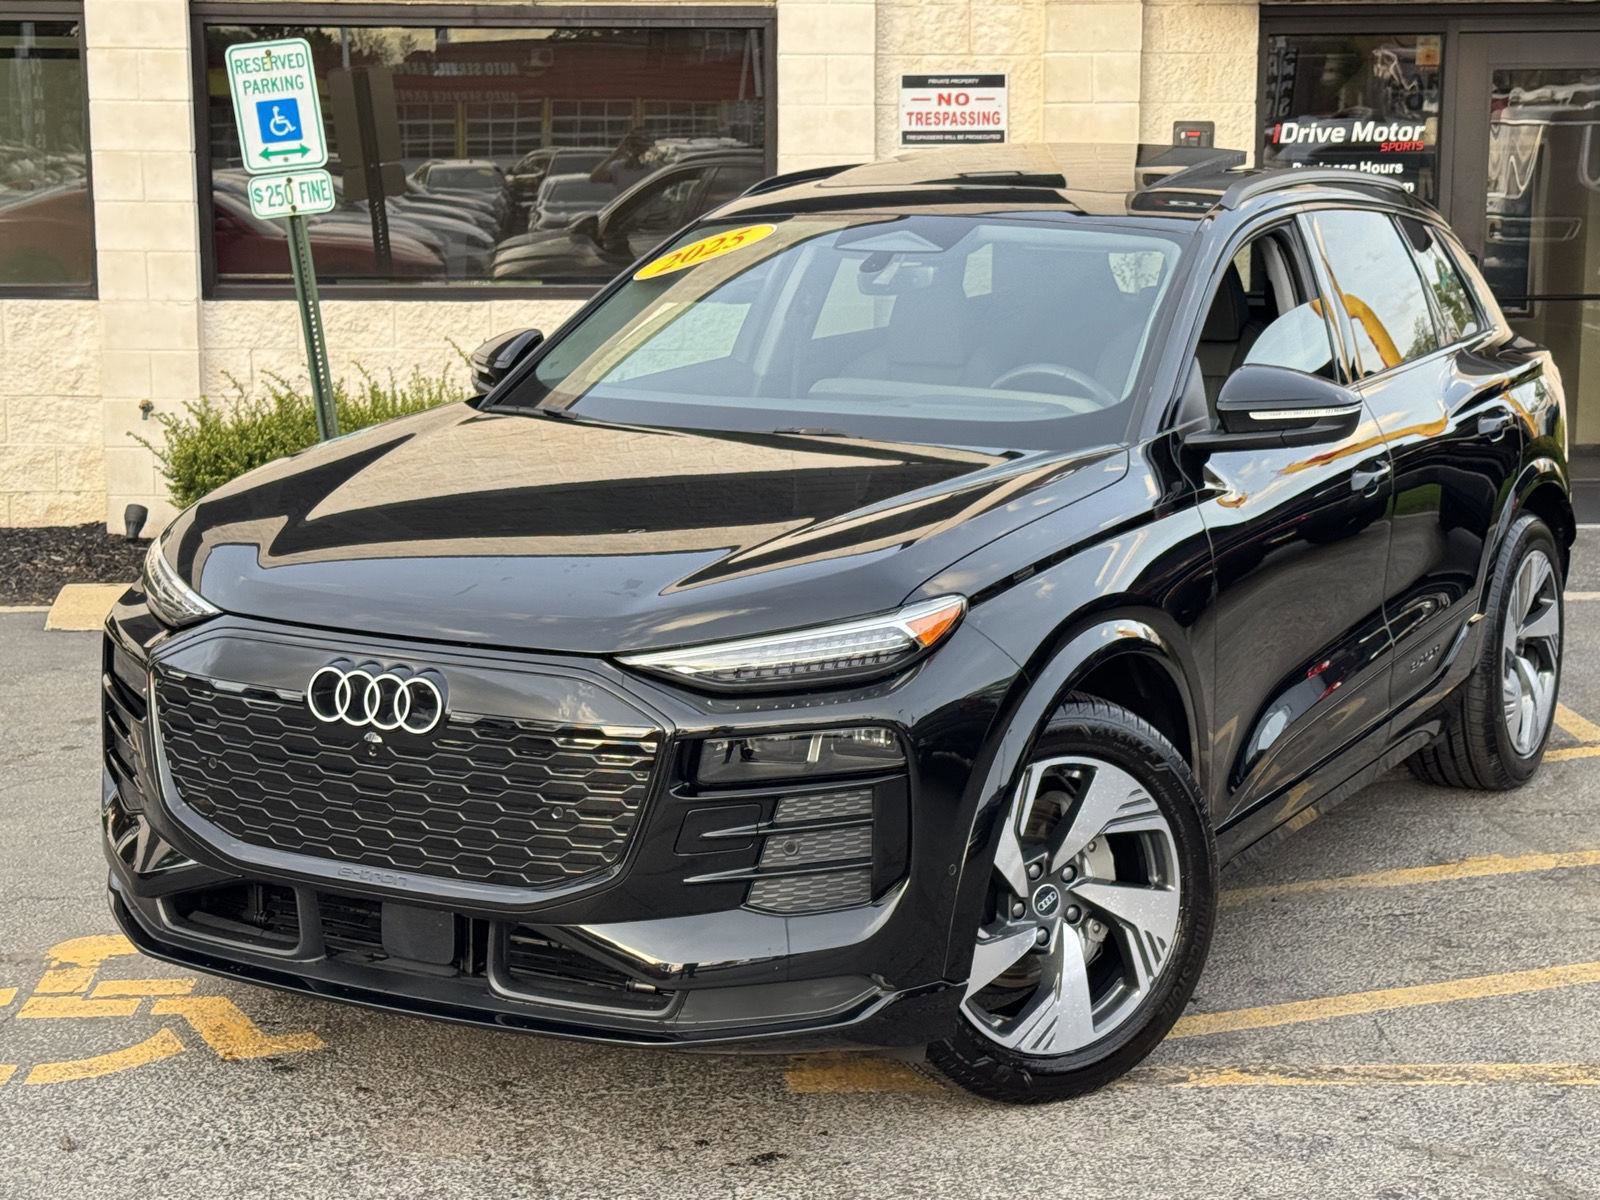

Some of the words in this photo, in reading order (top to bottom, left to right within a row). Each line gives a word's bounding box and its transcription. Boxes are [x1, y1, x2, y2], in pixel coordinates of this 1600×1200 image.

[234, 53, 305, 75] RESERVED
[243, 75, 304, 96] PARKING
[937, 93, 970, 106] NO
[906, 111, 1001, 126] TRESPASSING
[1351, 120, 1427, 143] Motor
[1380, 140, 1424, 153] SPORTS
[1360, 161, 1404, 174] Hours
[253, 183, 294, 208] $250
[299, 179, 331, 203] FINE
[655, 229, 752, 274] 2025
